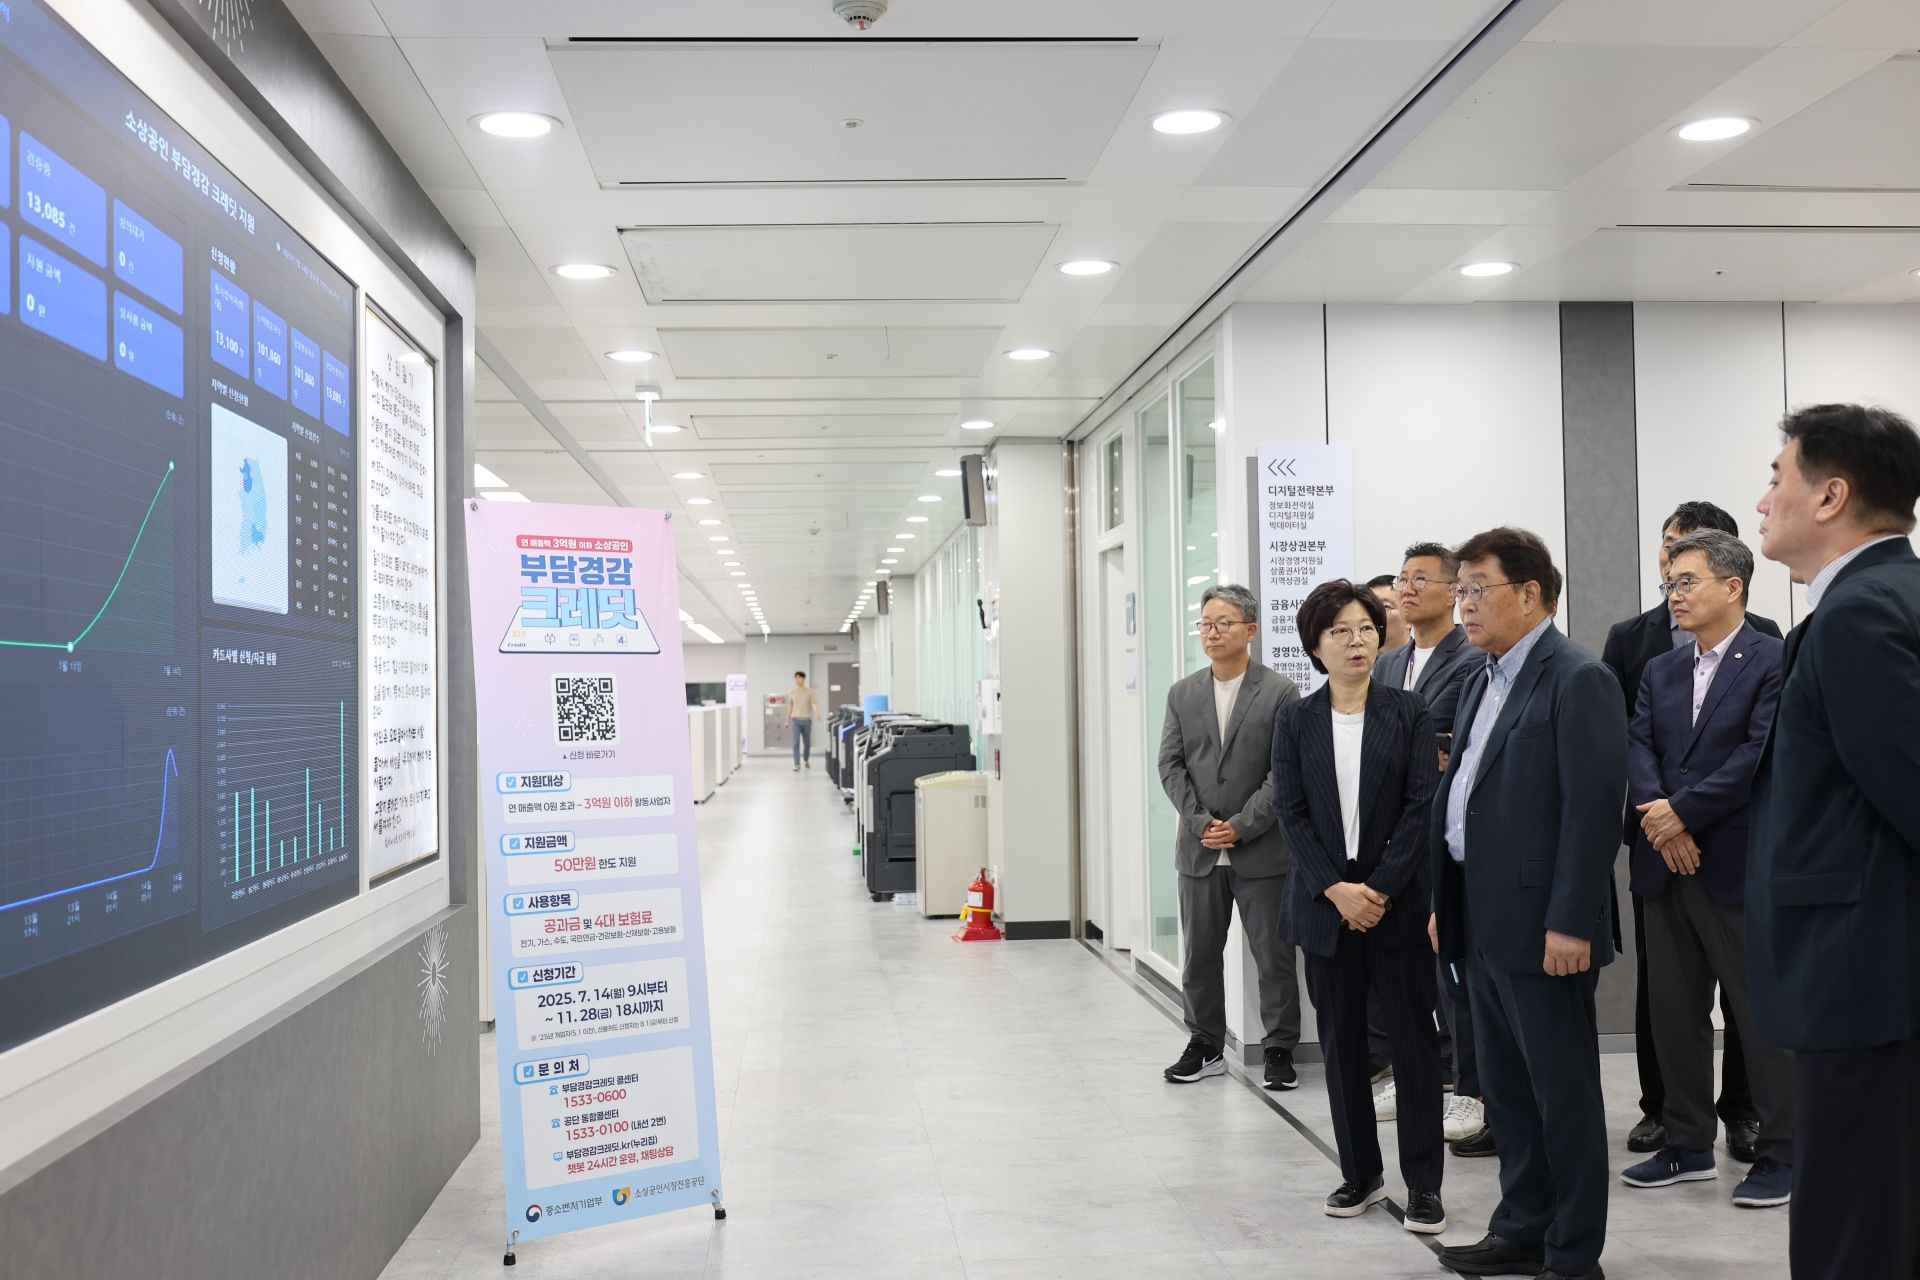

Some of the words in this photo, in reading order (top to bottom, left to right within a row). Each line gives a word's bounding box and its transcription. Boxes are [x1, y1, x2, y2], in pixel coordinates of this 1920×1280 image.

[125, 110, 168, 162] 소상공인
[171, 146, 210, 196] 부담경감
[211, 183, 237, 220] 크레딧
[239, 206, 255, 235] 지원
[27, 191, 65, 229] 13,085
[119, 251, 126, 267] 0
[26, 293, 35, 311] 0
[119, 342, 126, 358] 0
[215, 330, 238, 354] 13,100
[1268, 485, 1334, 497] 디지털전략본부
[1269, 501, 1314, 510] 정보화전략실
[1269, 511, 1314, 520] 디지털지원실
[1269, 521, 1307, 530] 빅데이터실
[553, 538, 577, 549] 3억원
[594, 540, 629, 551] 소상공인
[1269, 541, 1326, 552] 시장상권본부
[1270, 556, 1323, 566] 시장경영지원실
[520, 554, 633, 586] 부담경감
[1270, 566, 1316, 576] 상품권사업실
[1270, 577, 1309, 586] 지역상권실
[520, 586, 638, 629] 크레딧
[1271, 615, 1297, 624] 금융지
[1273, 662, 1310, 672] 경영안정실
[569, 751, 584, 760] 신청
[585, 750, 616, 759] 바로가기
[520, 775, 564, 788] 지원대상
[508, 803, 516, 813] 연
[518, 803, 542, 813] 매출액
[543, 802, 558, 812] 0원
[559, 801, 575, 811] 초과
[584, 797, 611, 809] 3억원
[613, 796, 633, 808] 이하
[634, 796, 671, 807] 활동사업자
[524, 835, 568, 850] 지원금액
[554, 856, 596, 873] 50만원
[598, 858, 617, 869] 한도
[618, 857, 637, 868] 지원
[528, 894, 571, 909] 사용항목
[544, 917, 580, 933] 공과금
[583, 919, 592, 930] 및
[594, 914, 615, 928] 4대
[618, 910, 653, 927] 보험료
[537, 938, 553, 947] 가스,
[553, 936, 569, 945] 수도,
[532, 966, 576, 982] 신청기간
[537, 993, 576, 1008] 2025.
[578, 990, 591, 1004] 7.
[594, 987, 625, 1002] 14(월)
[628, 980, 668, 997] 9시부터
[557, 1010, 578, 1024] 11.
[580, 1007, 612, 1022] 28(금)
[616, 999, 663, 1017] 18시까지
[538, 1063, 550, 1077] 문
[553, 1060, 565, 1075] 의
[568, 1059, 579, 1072] 처
[562, 1076, 615, 1093] 부담경감크레딧
[616, 1073, 639, 1086] 콜센터
[563, 1088, 627, 1108] 1533-0600
[564, 1115, 580, 1127] 공단
[581, 1108, 619, 1124] 통합콜센터
[566, 1120, 629, 1141] 1533-0100
[631, 1118, 650, 1131] (내선
[650, 1116, 667, 1128] 2번)
[566, 1135, 658, 1159] 부담경감크레딧.kr(누리집)
[587, 1156, 617, 1171] 24시간
[619, 1152, 639, 1165] 운영,
[640, 1146, 674, 1161] 채팅상담
[545, 1196, 603, 1217] 중소벤처기업부
[634, 1175, 705, 1198] 소상공인시장진흥공단
